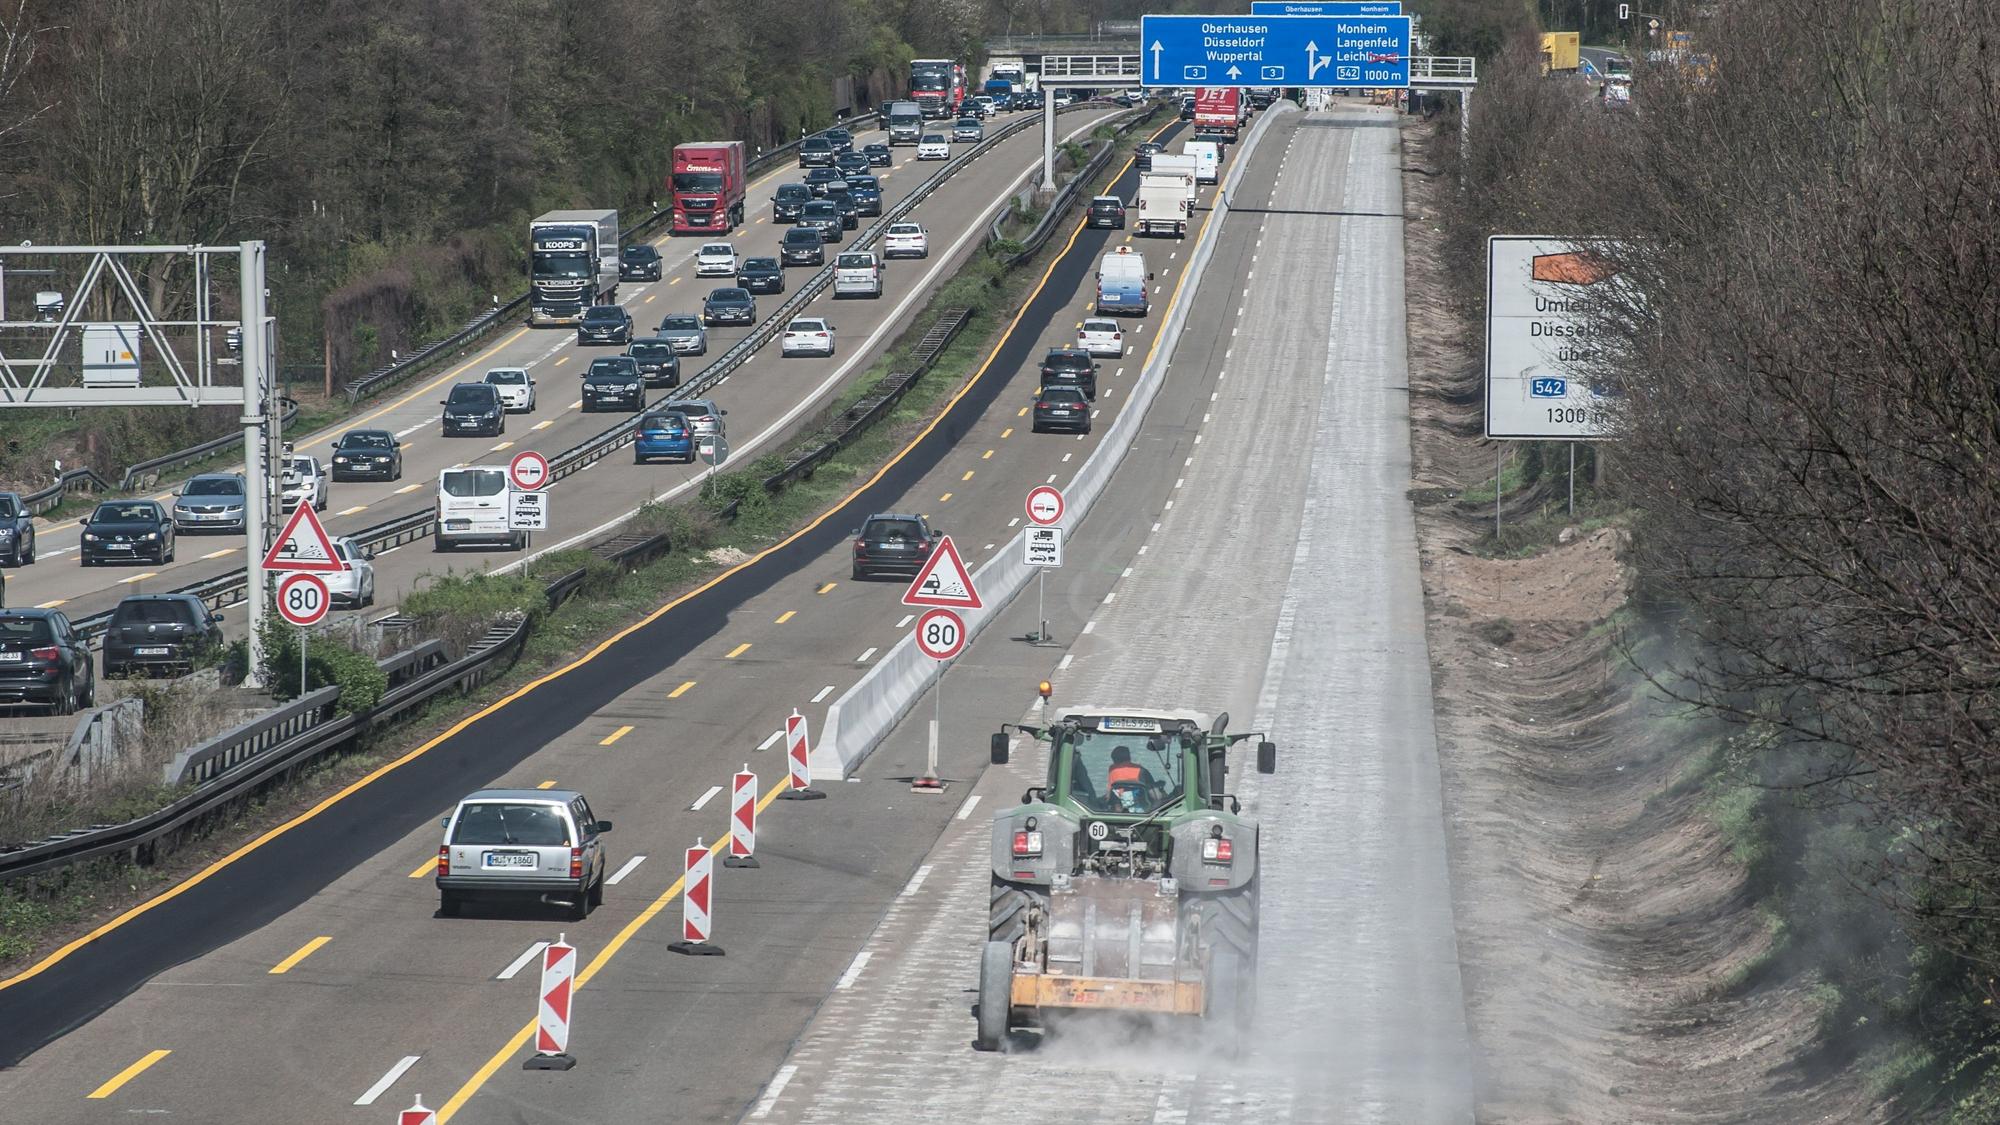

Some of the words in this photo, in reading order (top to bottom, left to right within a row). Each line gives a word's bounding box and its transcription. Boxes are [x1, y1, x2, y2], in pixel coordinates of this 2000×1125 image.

[1202, 23, 1268, 33] Oberhausen
[1337, 23, 1387, 33] Monheim
[1204, 37, 1265, 47] Düsseldorf
[1337, 37, 1399, 50] Langenfeld
[1206, 50, 1263, 63] Wuppertal
[1192, 68, 1199, 77] 3
[1269, 68, 1276, 77] 3
[1340, 69, 1357, 77] 542
[1365, 70, 1389, 80] 1000
[1391, 72, 1402, 80] m
[1198, 88, 1230, 101] JET
[545, 241, 575, 249] KOOPS
[1535, 381, 1562, 394] 542
[1547, 408, 1585, 423] 1300
[289, 587, 318, 610] 80
[927, 624, 955, 646] 80
[1093, 825, 1104, 836] 60
